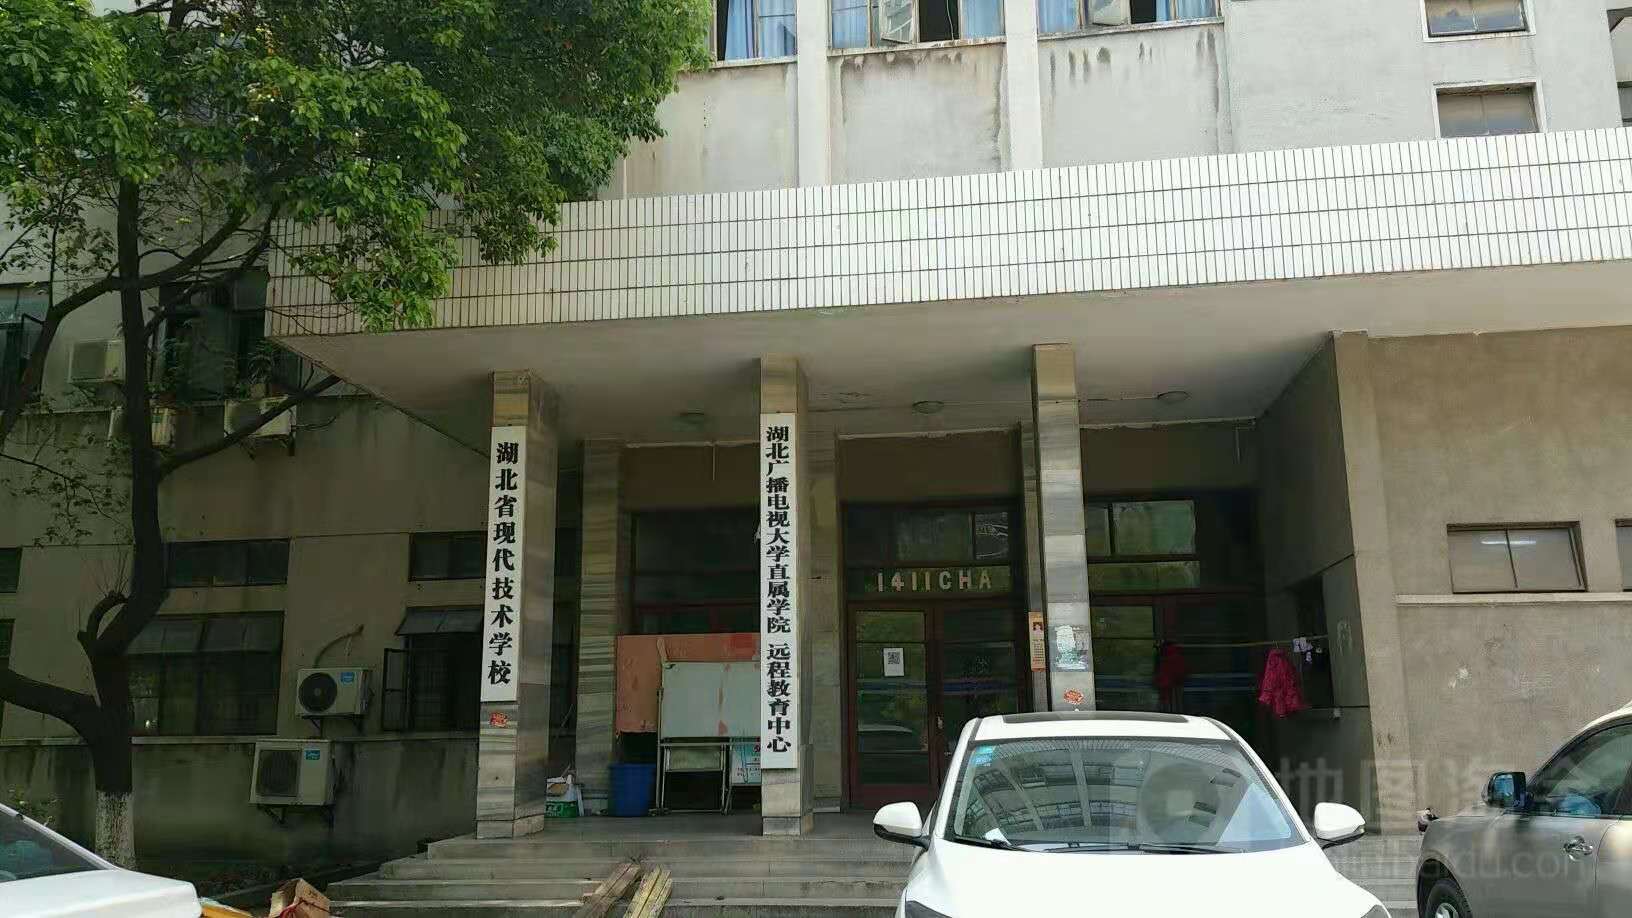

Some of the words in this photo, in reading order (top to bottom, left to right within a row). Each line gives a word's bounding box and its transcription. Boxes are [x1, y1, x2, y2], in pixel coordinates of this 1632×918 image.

[487, 441, 519, 686] 湖北省现代技术学校
[765, 425, 791, 634] 湖北广播电视大学直属学院
[766, 642, 792, 753] 远程教育中心
